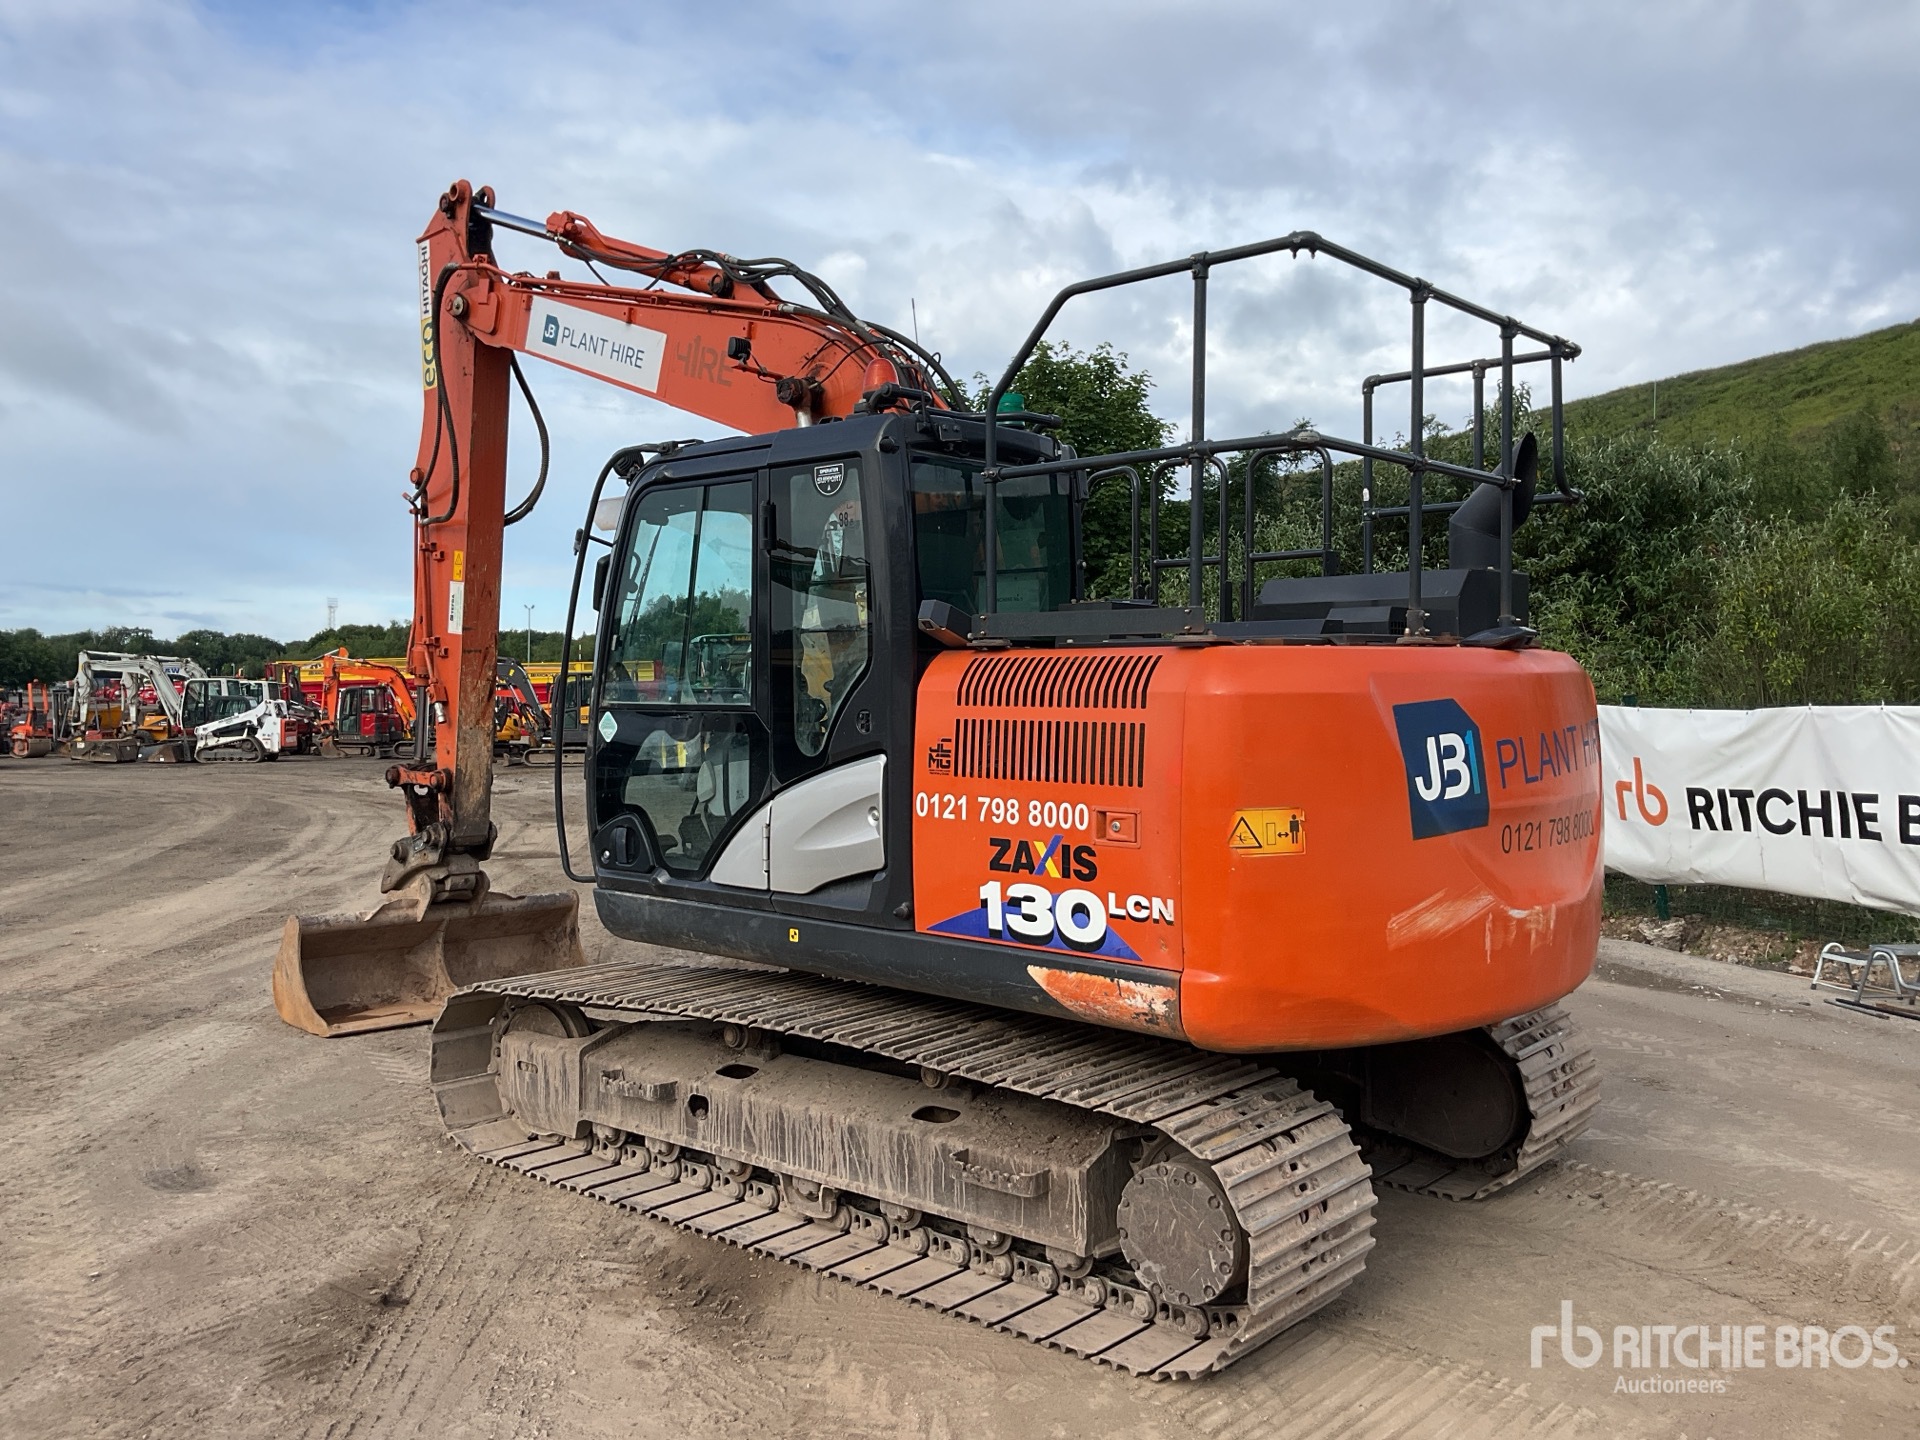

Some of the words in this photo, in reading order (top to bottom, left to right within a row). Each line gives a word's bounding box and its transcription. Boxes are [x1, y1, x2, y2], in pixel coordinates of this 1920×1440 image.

[421, 246, 430, 315] HITACHI
[561, 326, 608, 357] PLANT
[609, 341, 645, 369] HIRE
[817, 474, 842, 484] SUPPORT
[1496, 726, 1578, 789] PLANT
[916, 791, 967, 820] 0121
[977, 796, 1020, 825] 798
[1029, 800, 1089, 831] 8000
[1615, 757, 1669, 827] rb
[1686, 788, 1882, 842] RITCHIE
[1501, 820, 1542, 854] 0121
[1549, 816, 1570, 847] 798
[1573, 810, 1594, 840] 8000
[989, 834, 1098, 882] ZAXIS
[979, 881, 1107, 951] 130
[1108, 892, 1175, 926] LCN
